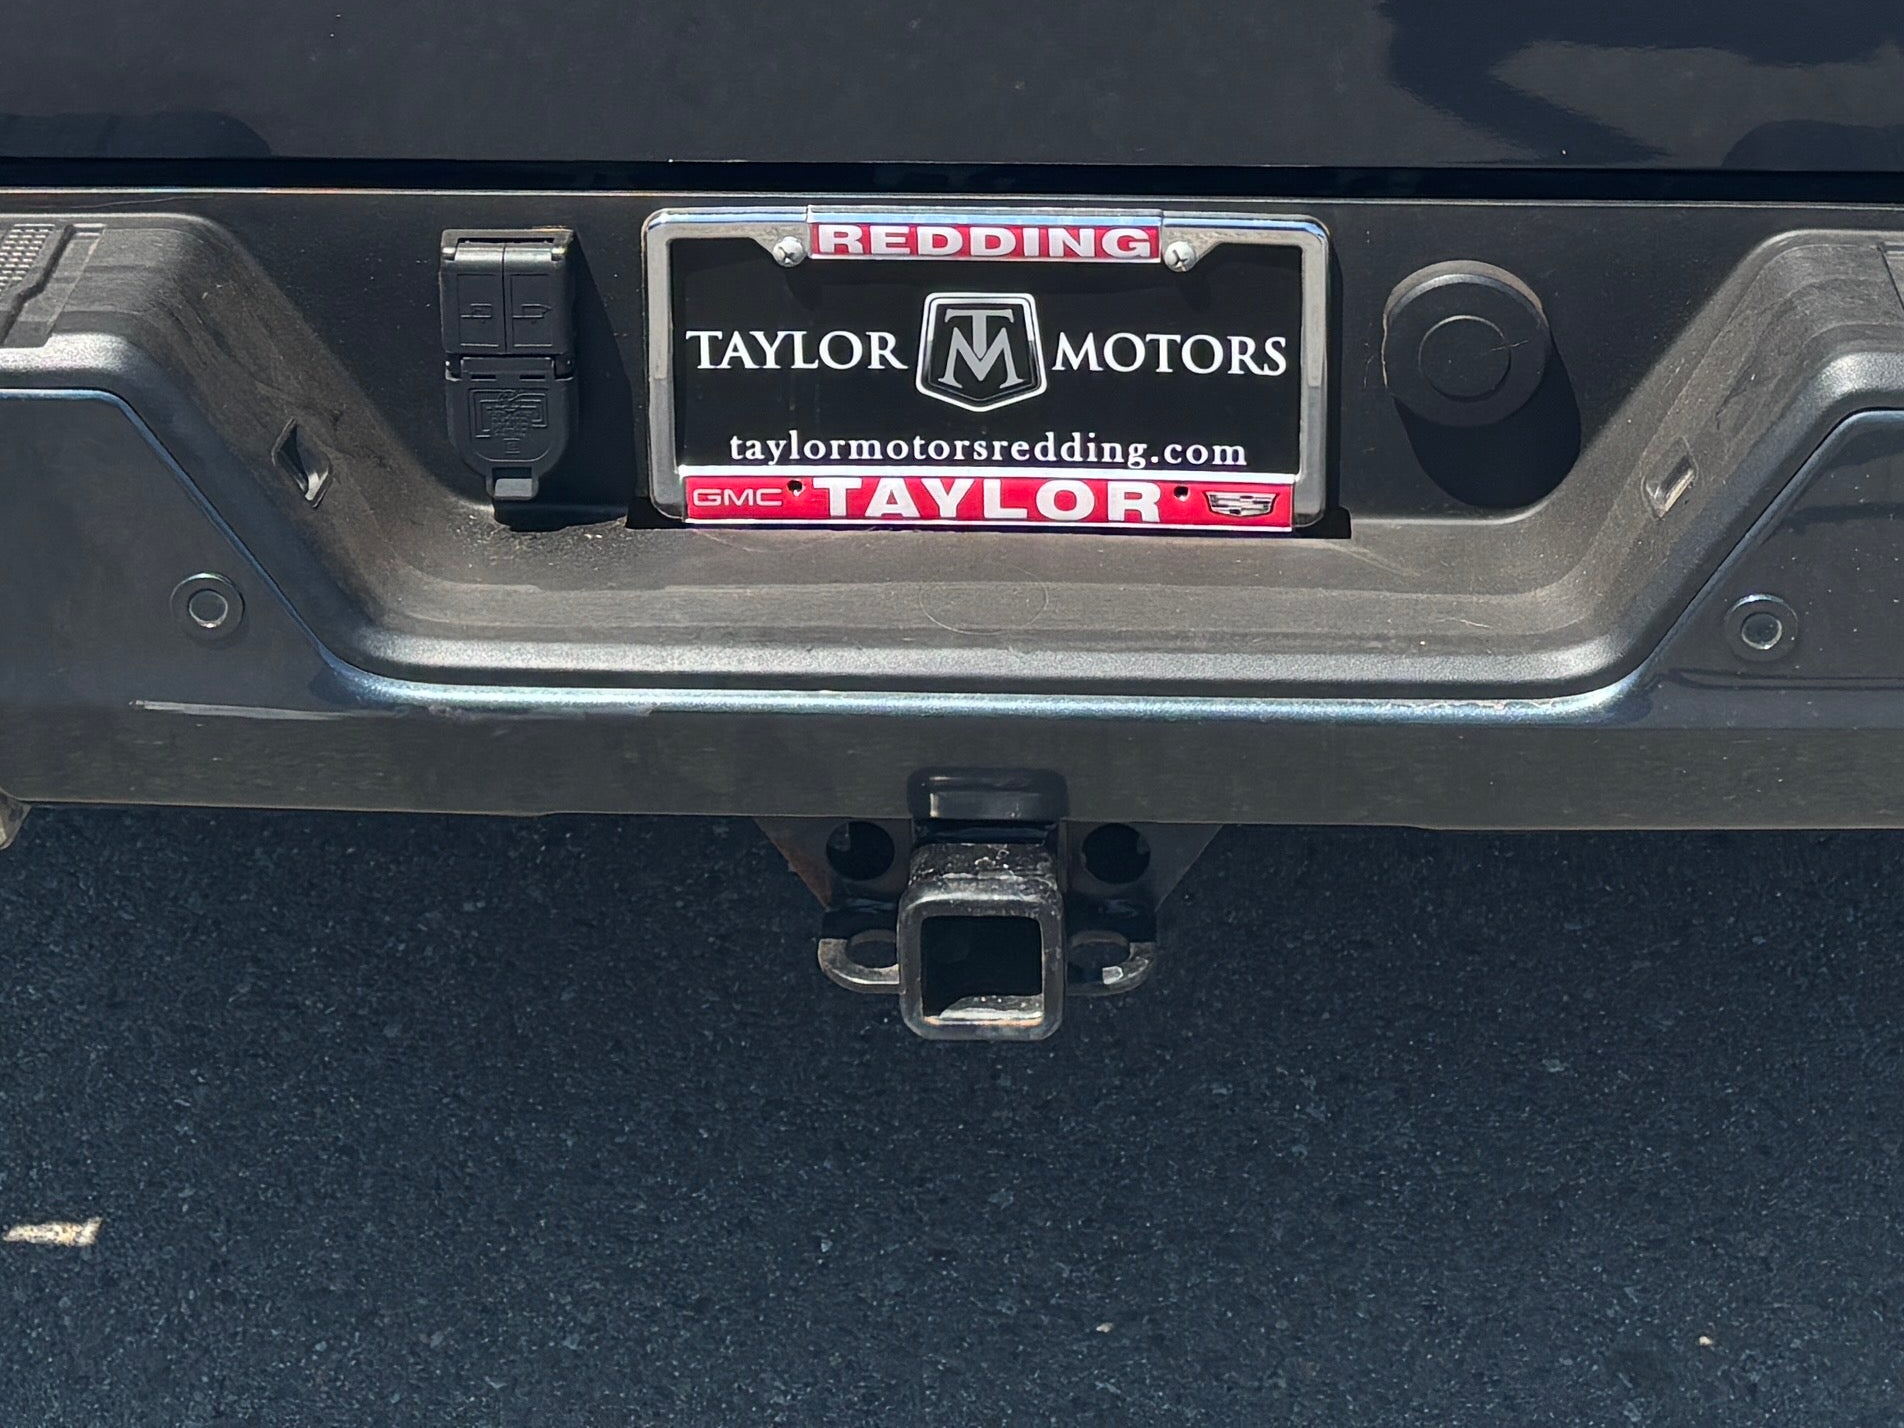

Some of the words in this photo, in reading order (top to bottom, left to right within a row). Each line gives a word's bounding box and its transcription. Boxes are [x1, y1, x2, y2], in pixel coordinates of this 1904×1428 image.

[817, 223, 1151, 259] REDDING
[685, 330, 909, 370] TAYLOR
[1050, 331, 1289, 377] MOTORS
[729, 429, 1248, 469] taylormotorsredding.com
[692, 488, 783, 508] GMC
[812, 476, 1162, 523] TAYLOR
